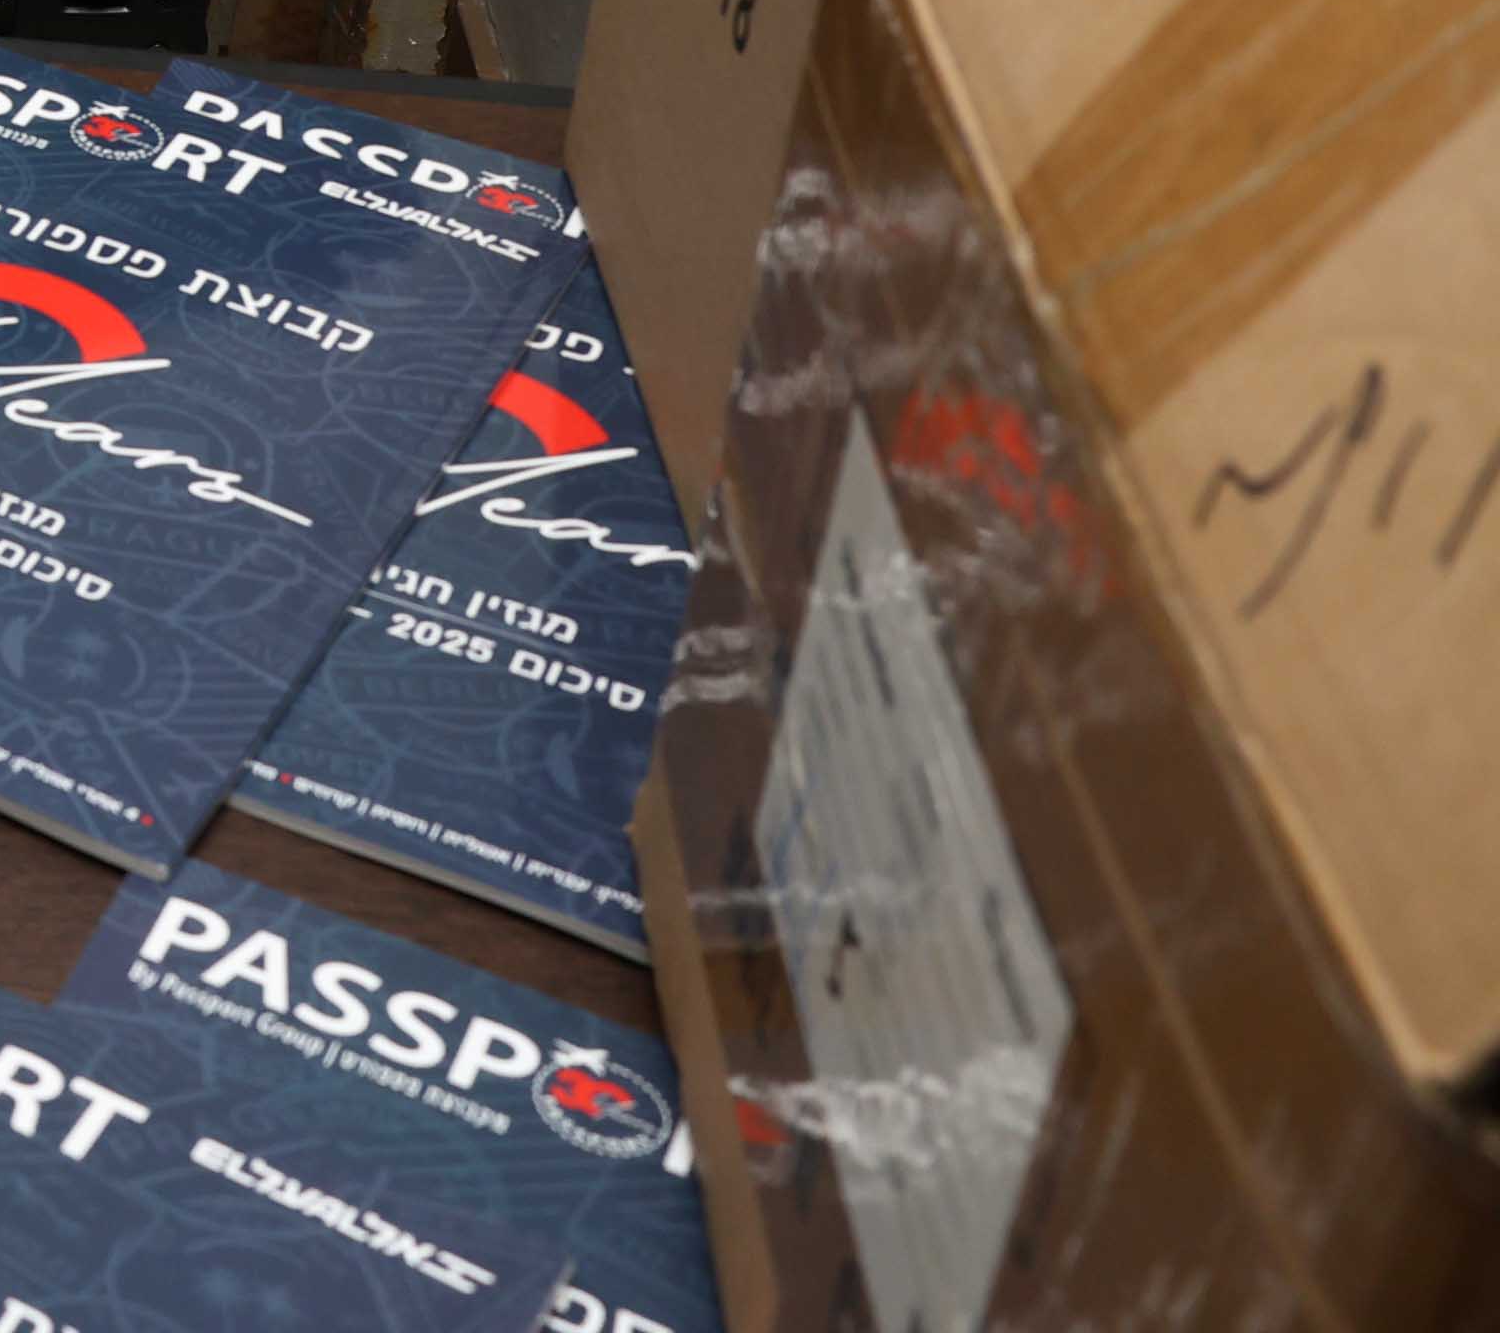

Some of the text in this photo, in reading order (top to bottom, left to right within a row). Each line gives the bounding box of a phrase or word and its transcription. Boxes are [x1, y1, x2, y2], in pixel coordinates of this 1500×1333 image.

[178, 266, 375, 357] קבוצת
[387, 612, 646, 712] סיכום 2025
[465, 593, 579, 645] מגזין
